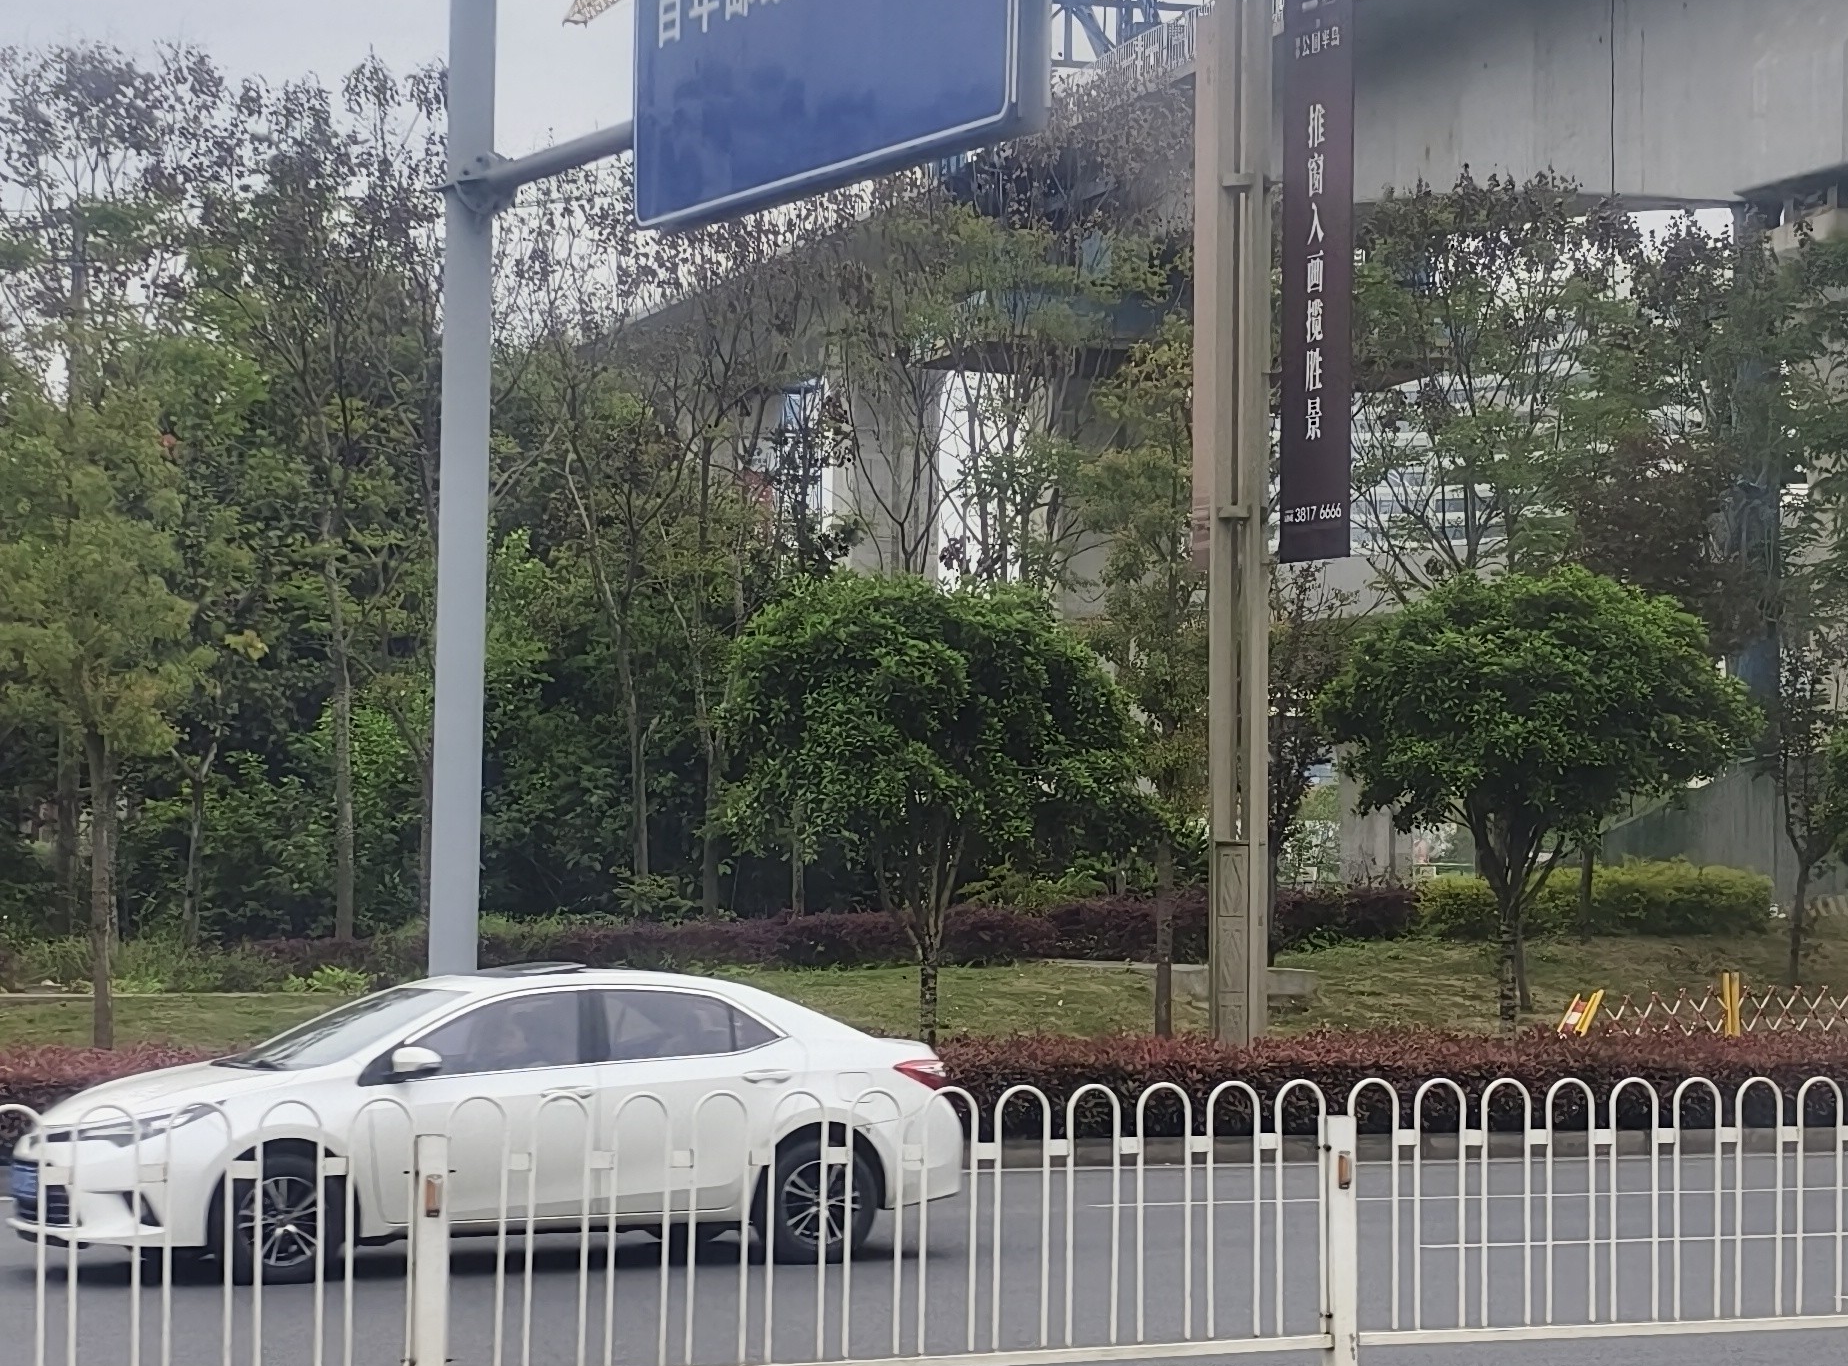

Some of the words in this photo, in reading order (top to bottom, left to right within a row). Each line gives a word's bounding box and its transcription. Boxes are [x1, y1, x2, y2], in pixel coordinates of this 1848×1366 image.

[1305, 103, 1325, 441] 推窗入画揽胜景
[1294, 505, 1317, 523] 3817
[1319, 502, 1342, 520] 6666
